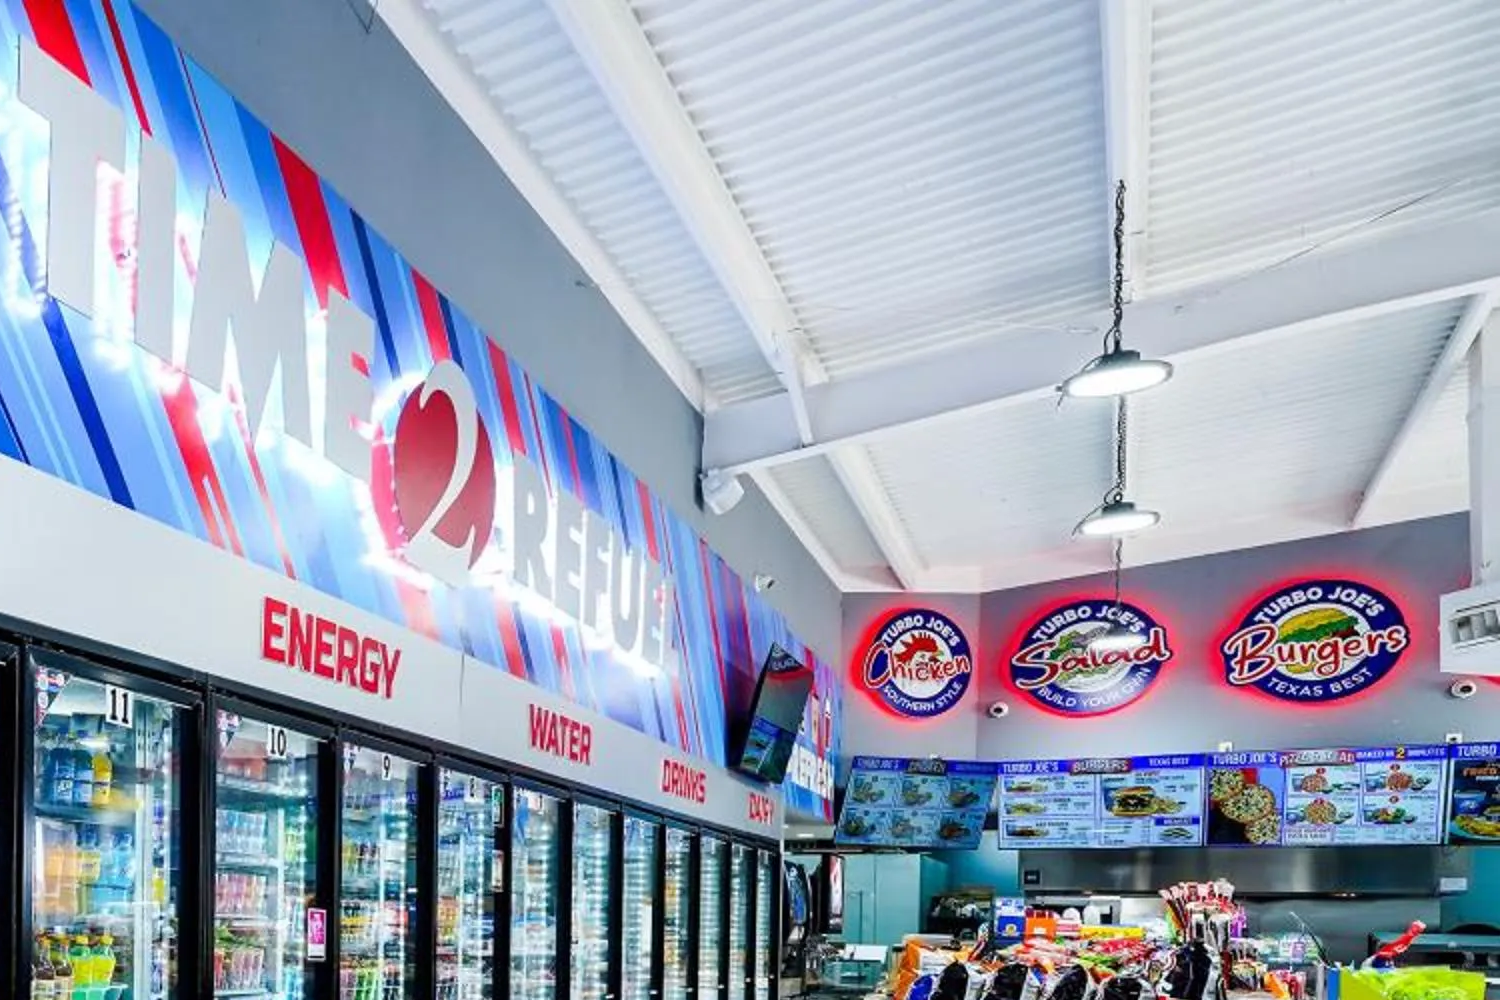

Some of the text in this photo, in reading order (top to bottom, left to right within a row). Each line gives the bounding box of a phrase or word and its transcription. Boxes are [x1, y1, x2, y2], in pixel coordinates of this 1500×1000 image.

[18, 34, 378, 484] TIME
[405, 360, 492, 588] 2
[1032, 603, 1147, 642] TURBO JOE'S
[1254, 585, 1386, 625] TURBO JOE'S
[261, 595, 401, 699] ENERGY
[882, 614, 960, 647] TURBO JOE'S
[863, 641, 971, 689] Chicken
[1011, 626, 1173, 690] Salad
[1223, 622, 1408, 686] Burgers
[883, 680, 963, 712] SOUTHERN STYLE
[1037, 667, 1152, 709] BUILD YOUR OWN
[1267, 667, 1374, 698] TEXAS BEST
[108, 687, 131, 723] 11
[269, 727, 287, 757] 10
[528, 703, 593, 766] WATER
[1395, 746, 1405, 759] 2
[1457, 744, 1497, 758] TURBO
[383, 755, 392, 777] 9
[1003, 763, 1033, 774] TURBO
[1213, 752, 1247, 764] TURBO
[661, 759, 707, 804] DRINKS
